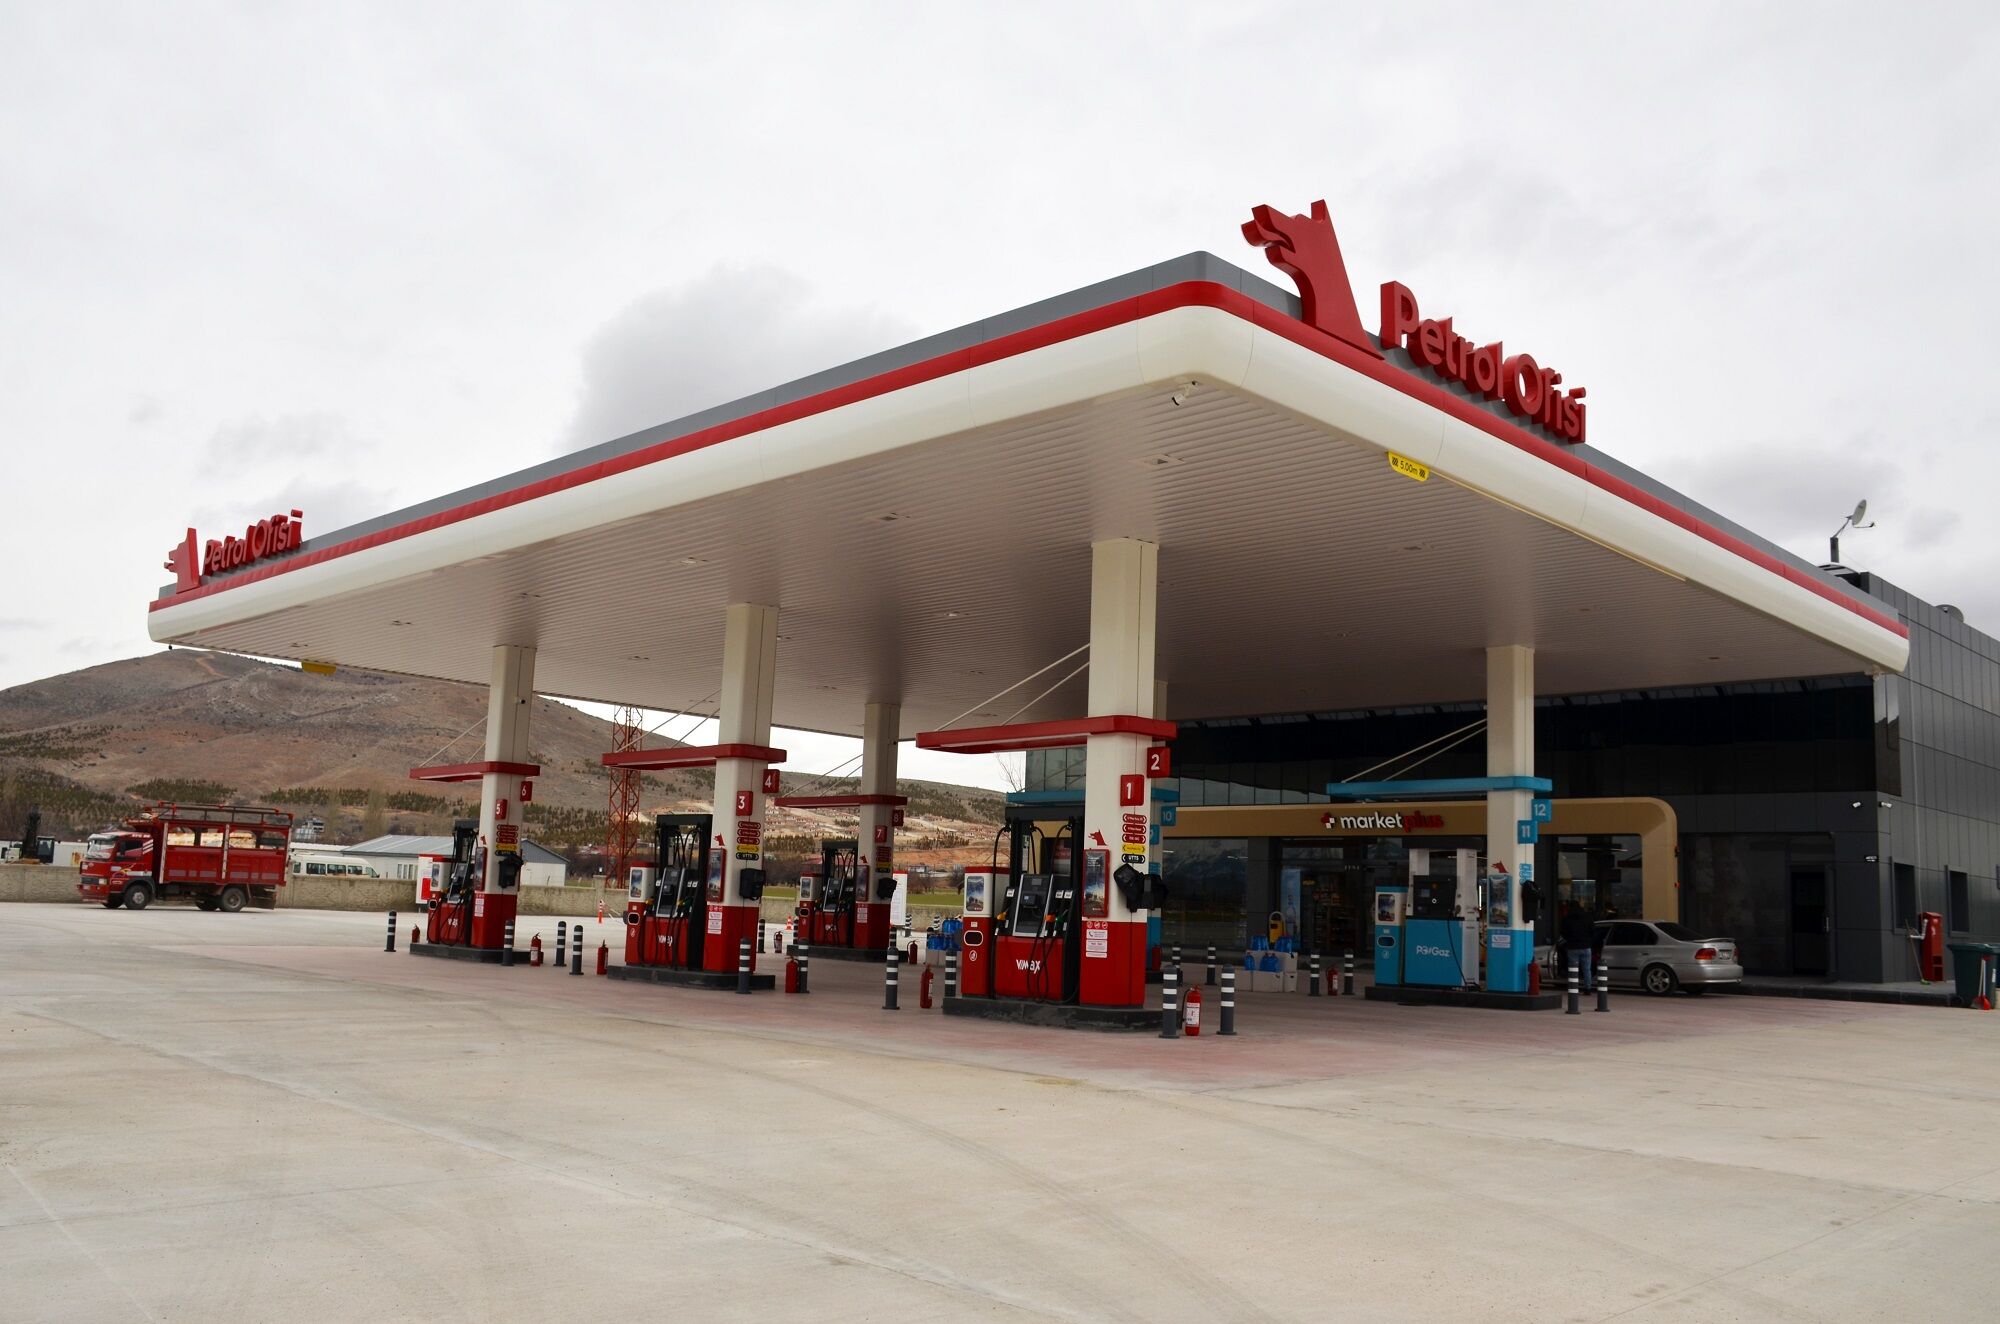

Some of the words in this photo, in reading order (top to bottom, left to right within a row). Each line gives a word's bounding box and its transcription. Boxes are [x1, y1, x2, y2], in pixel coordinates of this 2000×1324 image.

[1380, 280, 1503, 401] Petrol
[1503, 353, 1586, 443] Ofisi
[203, 526, 254, 576] Petrol
[252, 509, 303, 558] Ofisi
[1151, 754, 1160, 771] 2
[764, 776, 772, 788] 4
[521, 785, 526, 796] 6
[1126, 782, 1132, 800] 1
[496, 803, 501, 815] 5
[738, 795, 745, 810] 3
[1163, 811, 1172, 821] 10
[1534, 803, 1546, 816] 12
[1521, 825, 1530, 838] 11
